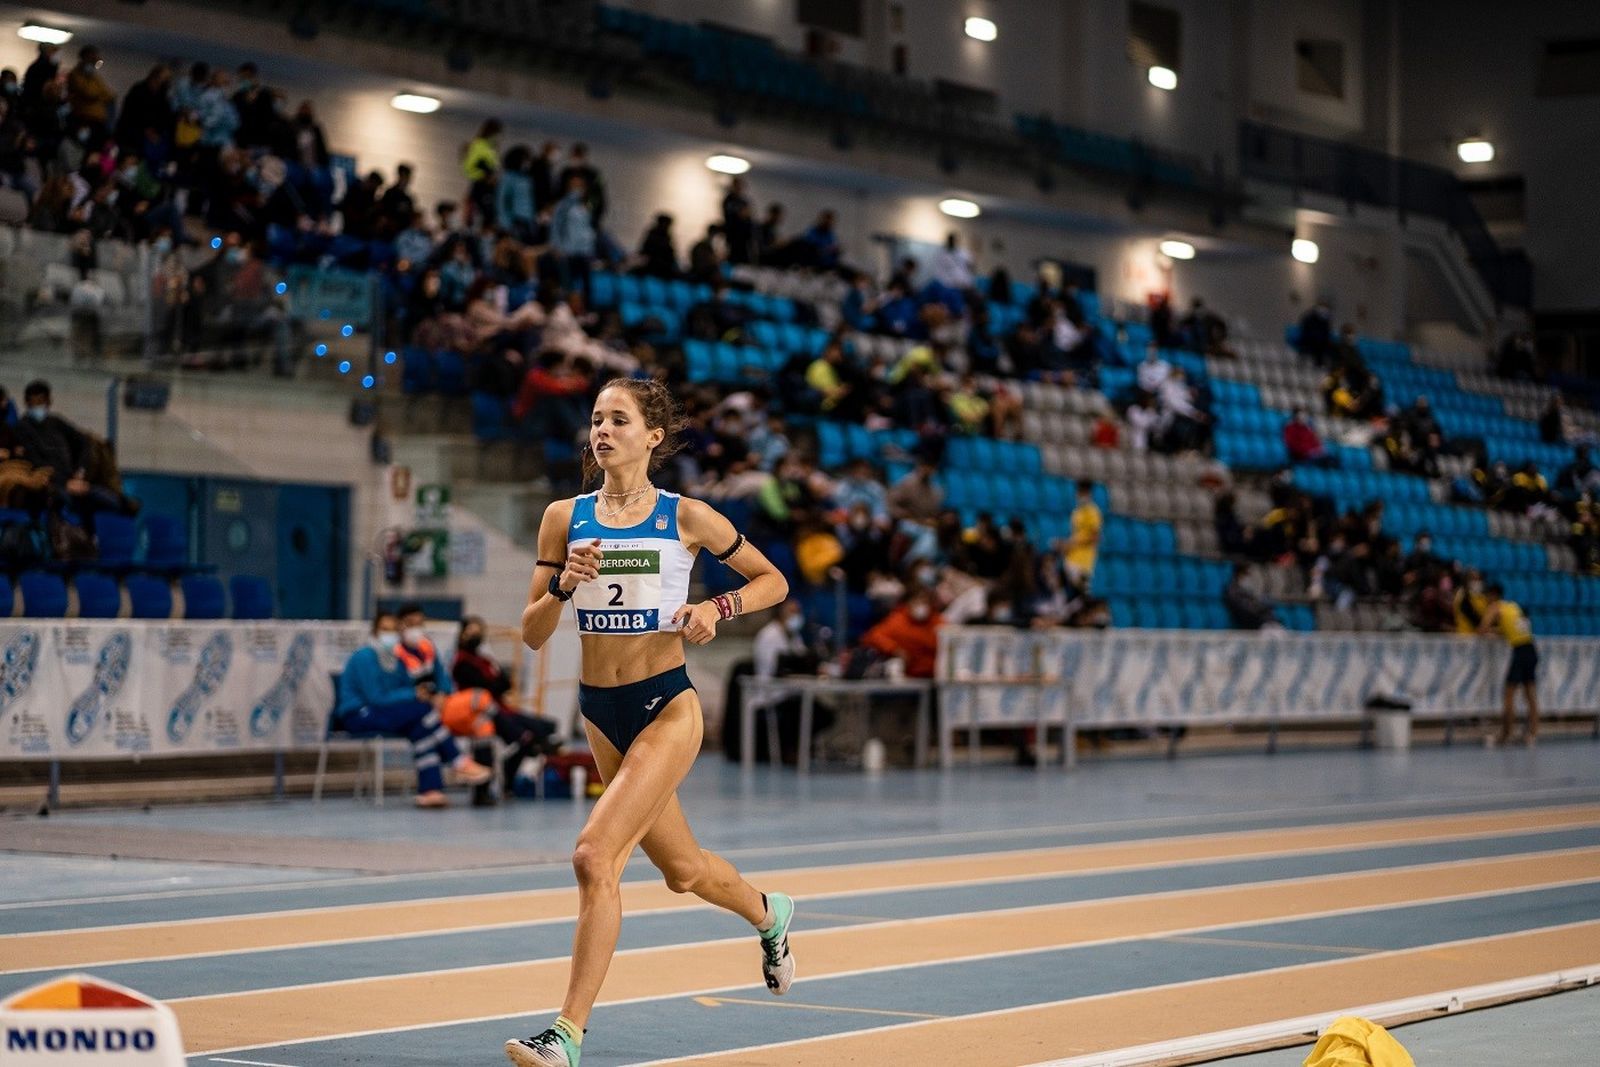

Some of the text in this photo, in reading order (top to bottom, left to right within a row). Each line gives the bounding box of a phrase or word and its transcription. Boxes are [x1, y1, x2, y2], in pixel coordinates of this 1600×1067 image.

[599, 559, 650, 568] BERDROLA
[608, 583, 624, 606] 2
[7, 1028, 156, 1052] MONDO
